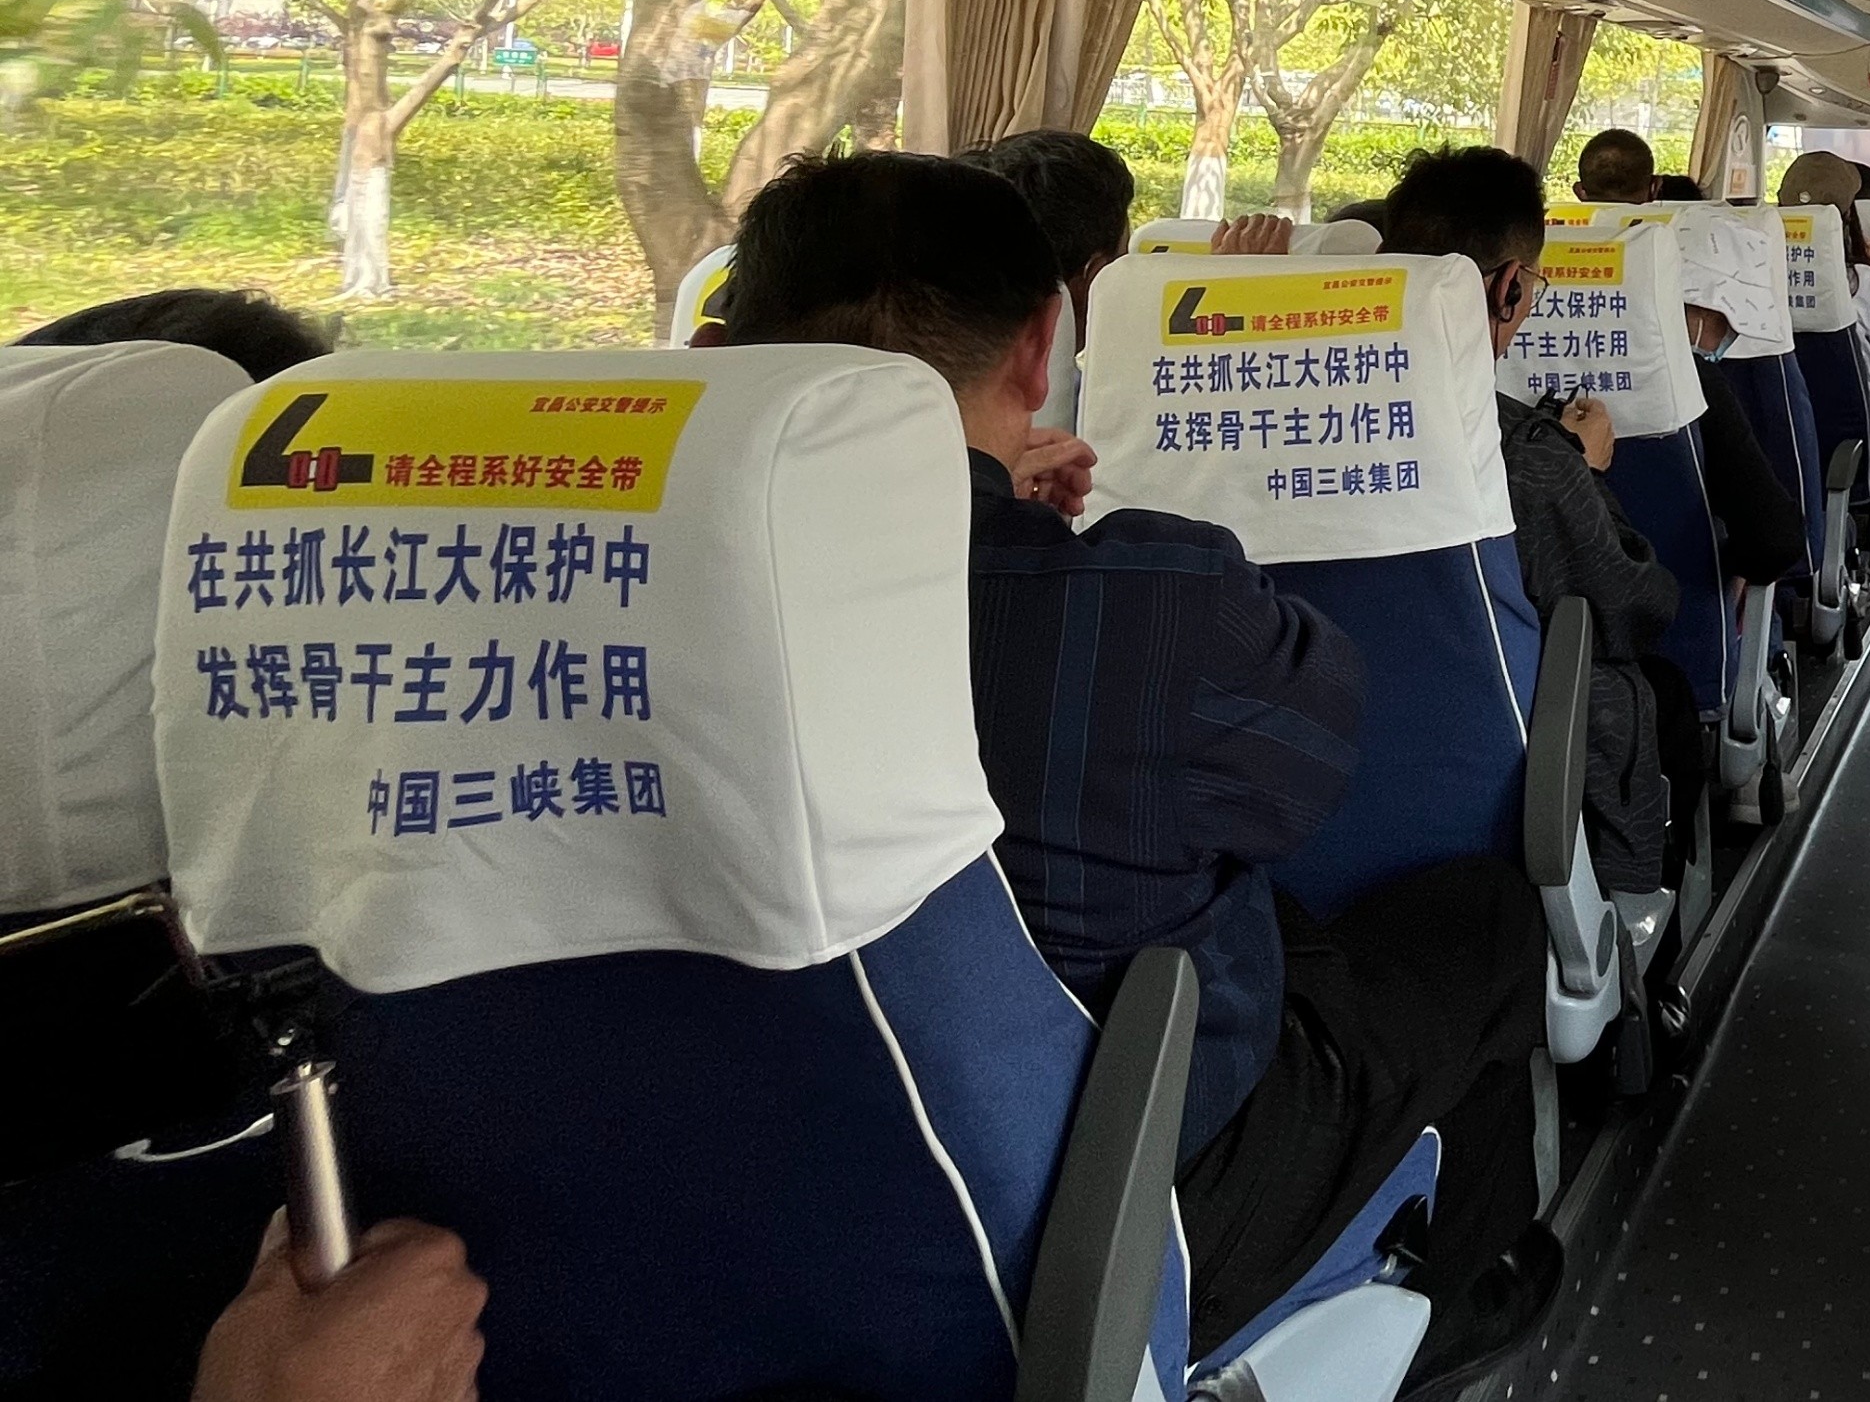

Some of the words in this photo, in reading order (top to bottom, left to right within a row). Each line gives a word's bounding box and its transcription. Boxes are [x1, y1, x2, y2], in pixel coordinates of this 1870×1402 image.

[1788, 270, 1815, 287] 作用
[1251, 305, 1389, 332] 请全程系好安全带
[1503, 330, 1628, 359] 干主力作用
[1153, 343, 1411, 397] 在共抓长江大保护中
[1155, 401, 1416, 452] 发挥骨干主力作用
[385, 454, 642, 492] 请全程系好安全带
[1266, 460, 1420, 502] 中国三峡集团
[187, 524, 651, 614] 在共抓长江大保护中
[197, 640, 652, 724] 发挥骨干主力作用
[367, 758, 666, 837] 中国三峡集团
